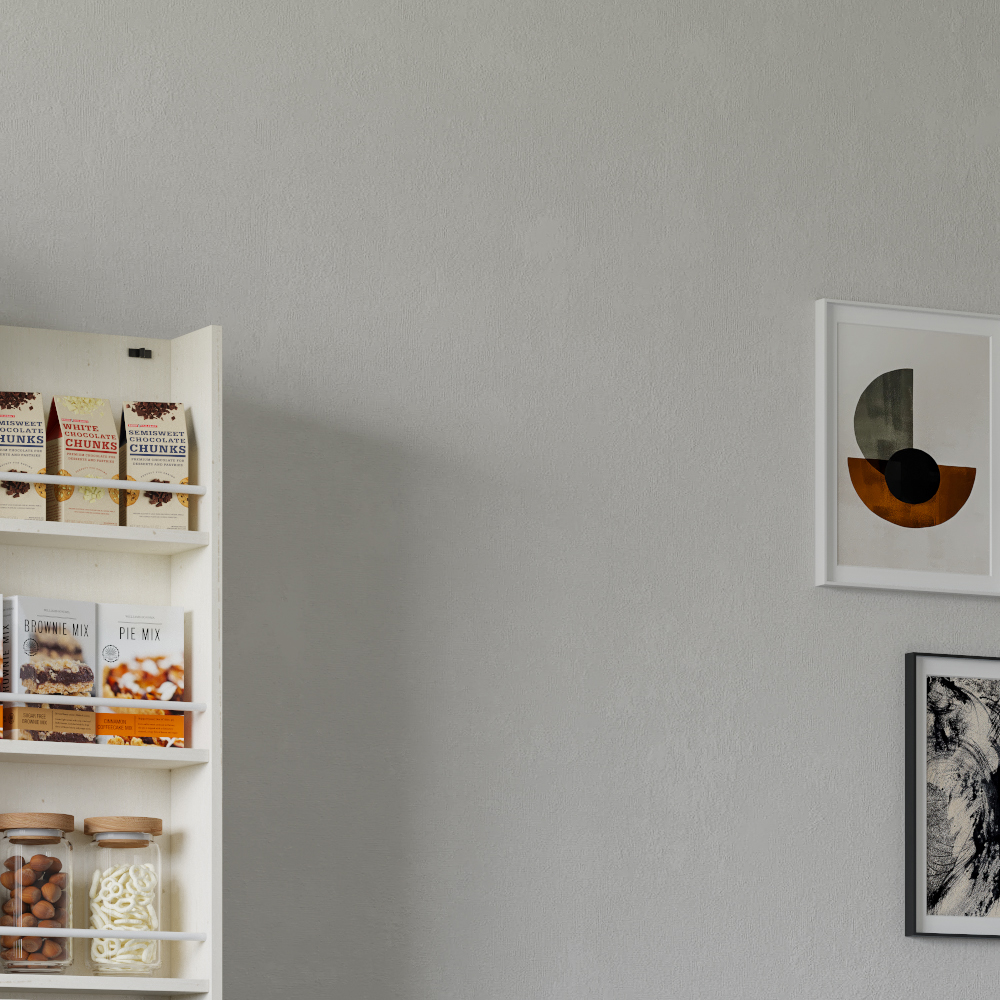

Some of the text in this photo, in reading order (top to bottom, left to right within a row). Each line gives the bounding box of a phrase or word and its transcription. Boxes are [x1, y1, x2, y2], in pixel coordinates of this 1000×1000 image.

[63, 423, 99, 432] WHITE
[64, 431, 117, 440] CHOCOLATE
[129, 436, 186, 444] CHOCOLATE
[65, 438, 117, 451] CHUNKS
[129, 443, 186, 454] CHUNKS
[24, 619, 89, 637] BROWNIE MIX
[119, 627, 160, 641] PIE MIX
